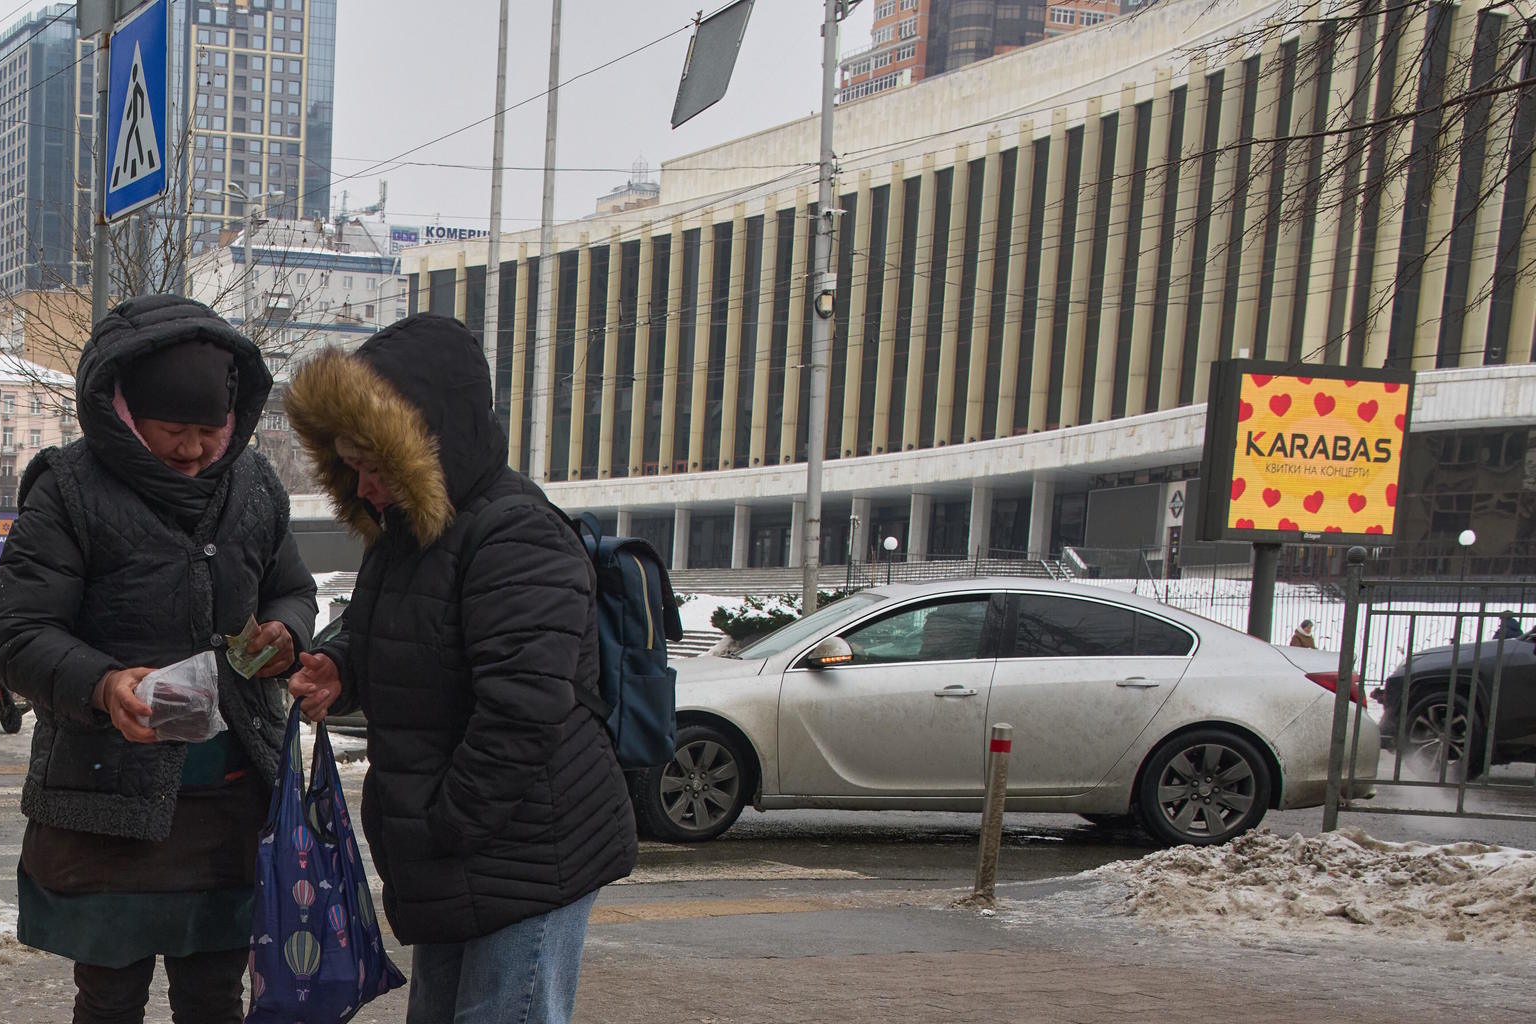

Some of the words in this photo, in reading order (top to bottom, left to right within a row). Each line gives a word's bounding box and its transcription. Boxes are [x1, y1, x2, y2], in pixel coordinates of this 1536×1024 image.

[1245, 430, 1392, 463] KARABAS
[1265, 463, 1302, 474] КВИТКИ
[1304, 465, 1317, 474] НА
[1321, 465, 1370, 478] КОНЦЕРТИ
